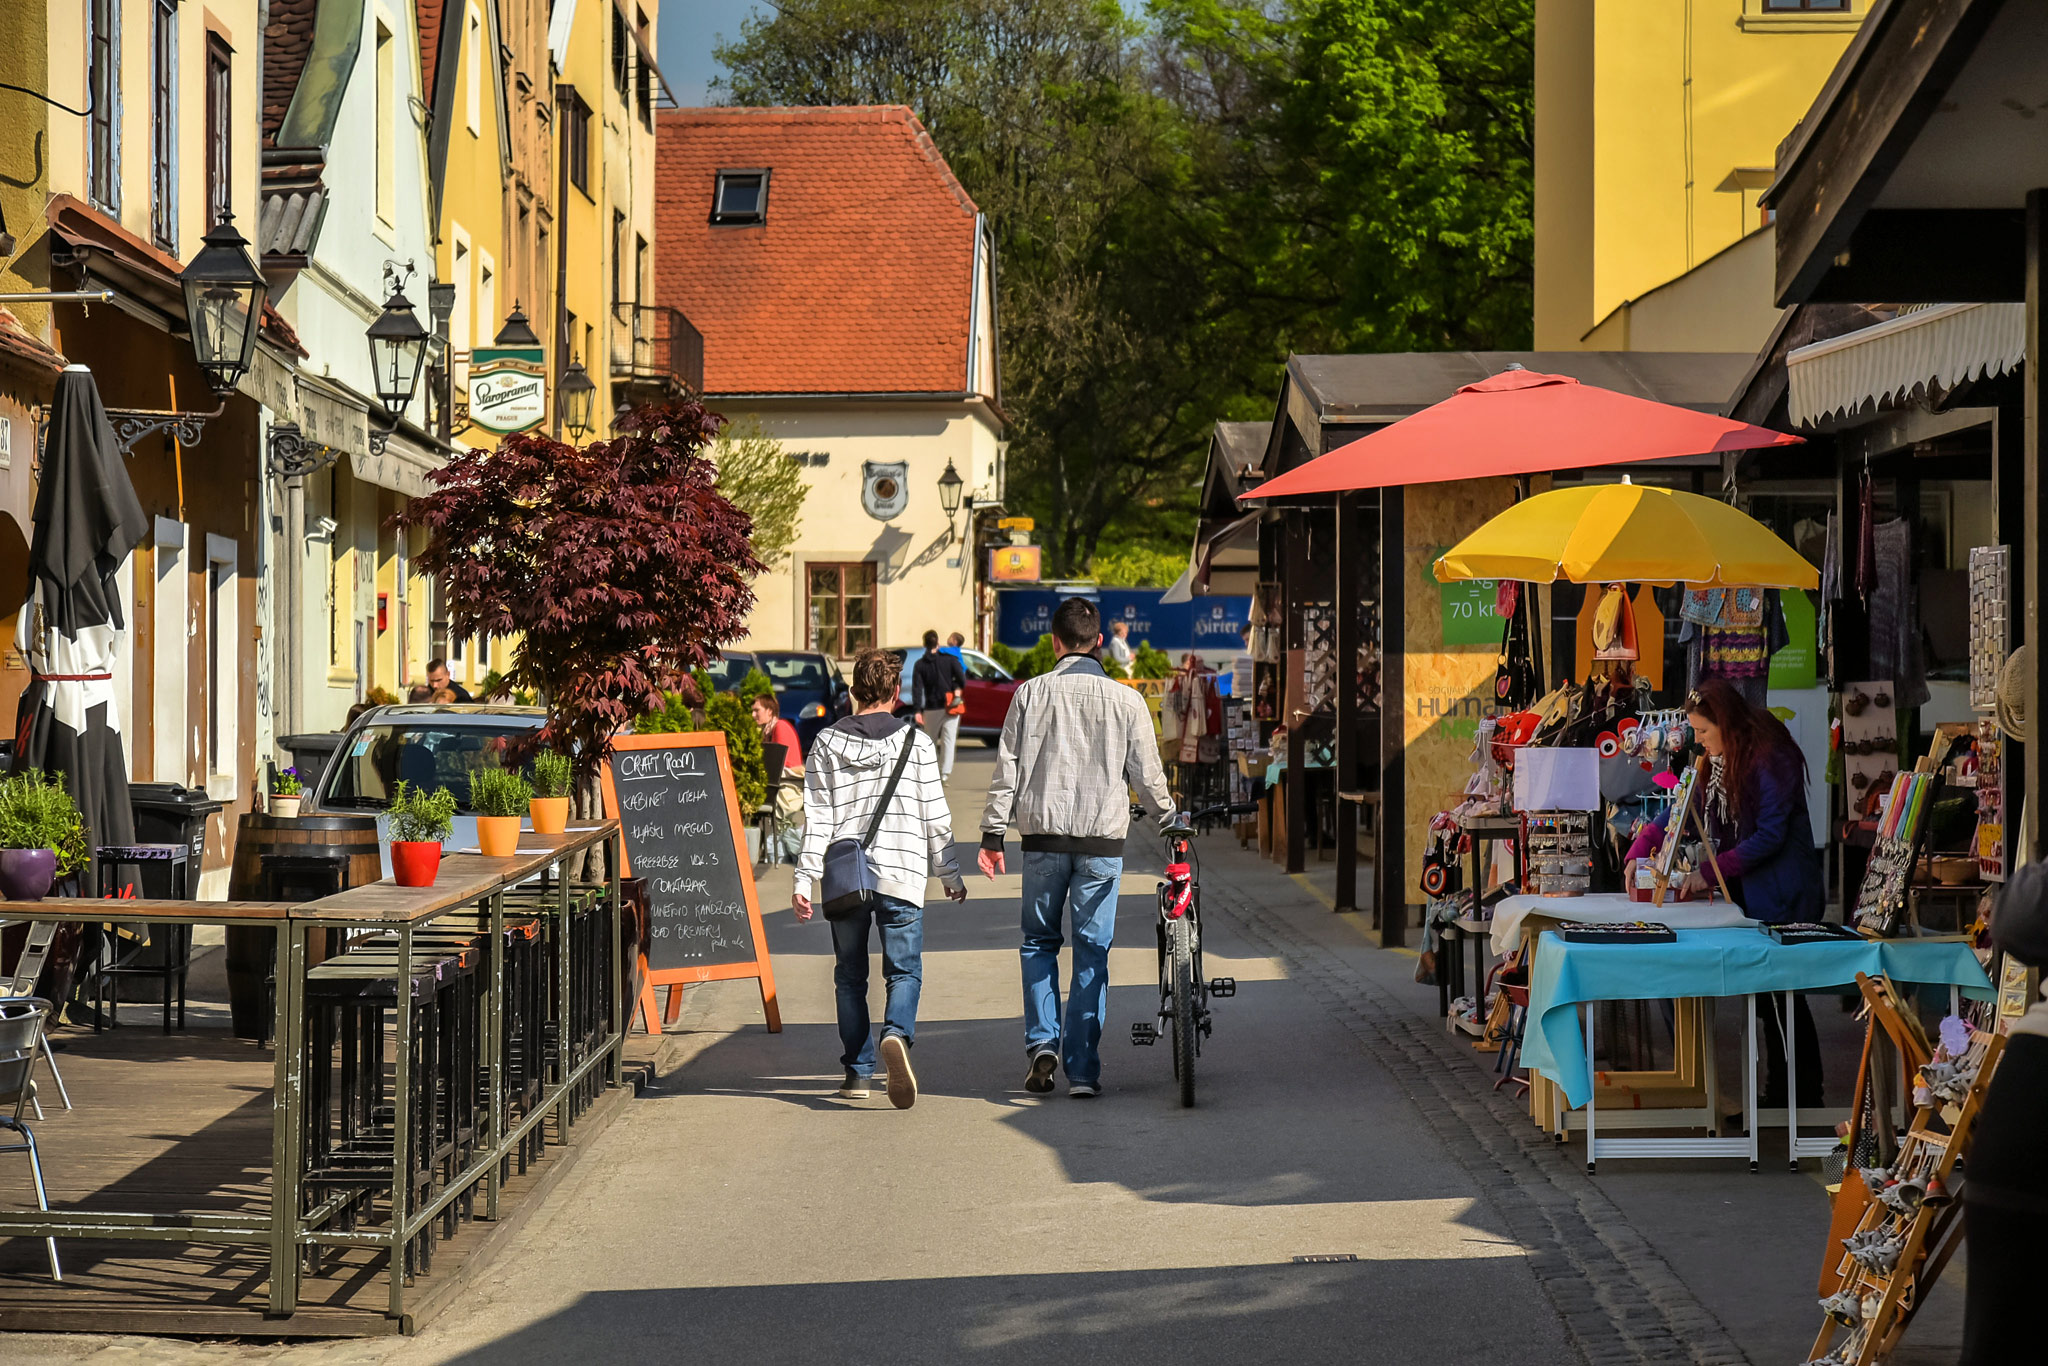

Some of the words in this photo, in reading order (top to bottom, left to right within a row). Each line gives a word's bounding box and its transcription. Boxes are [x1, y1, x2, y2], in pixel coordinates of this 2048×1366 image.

[475, 382, 539, 407] Staropramen
[1450, 602, 1472, 619] 70
[621, 753, 659, 776] CRAFT
[623, 788, 669, 811] KABINET
[674, 821, 713, 837] MRGUD
